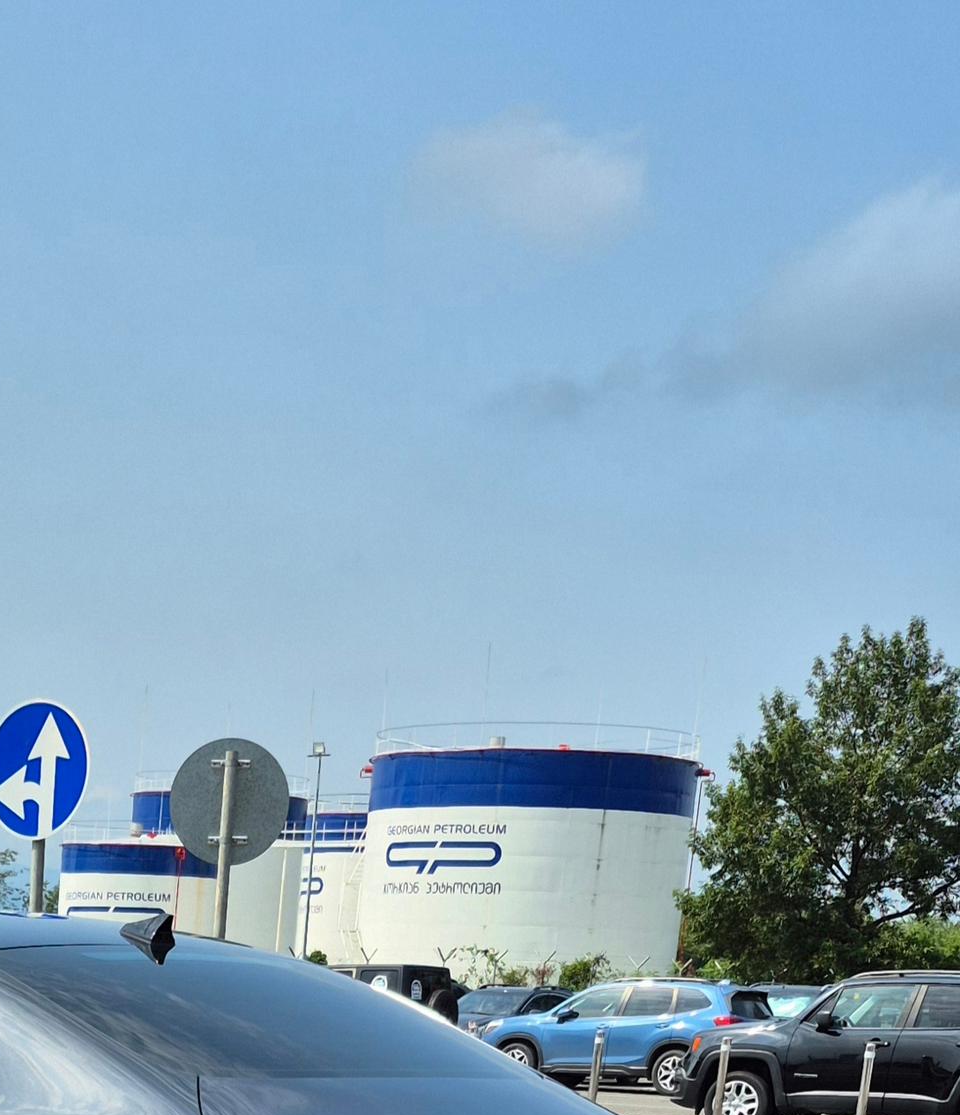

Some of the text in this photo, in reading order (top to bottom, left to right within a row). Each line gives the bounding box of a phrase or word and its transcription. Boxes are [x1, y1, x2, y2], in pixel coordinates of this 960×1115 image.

[387, 823, 507, 836] GEORGIAN PETROLEUM
[106, 892, 171, 903] PETROLEUM
